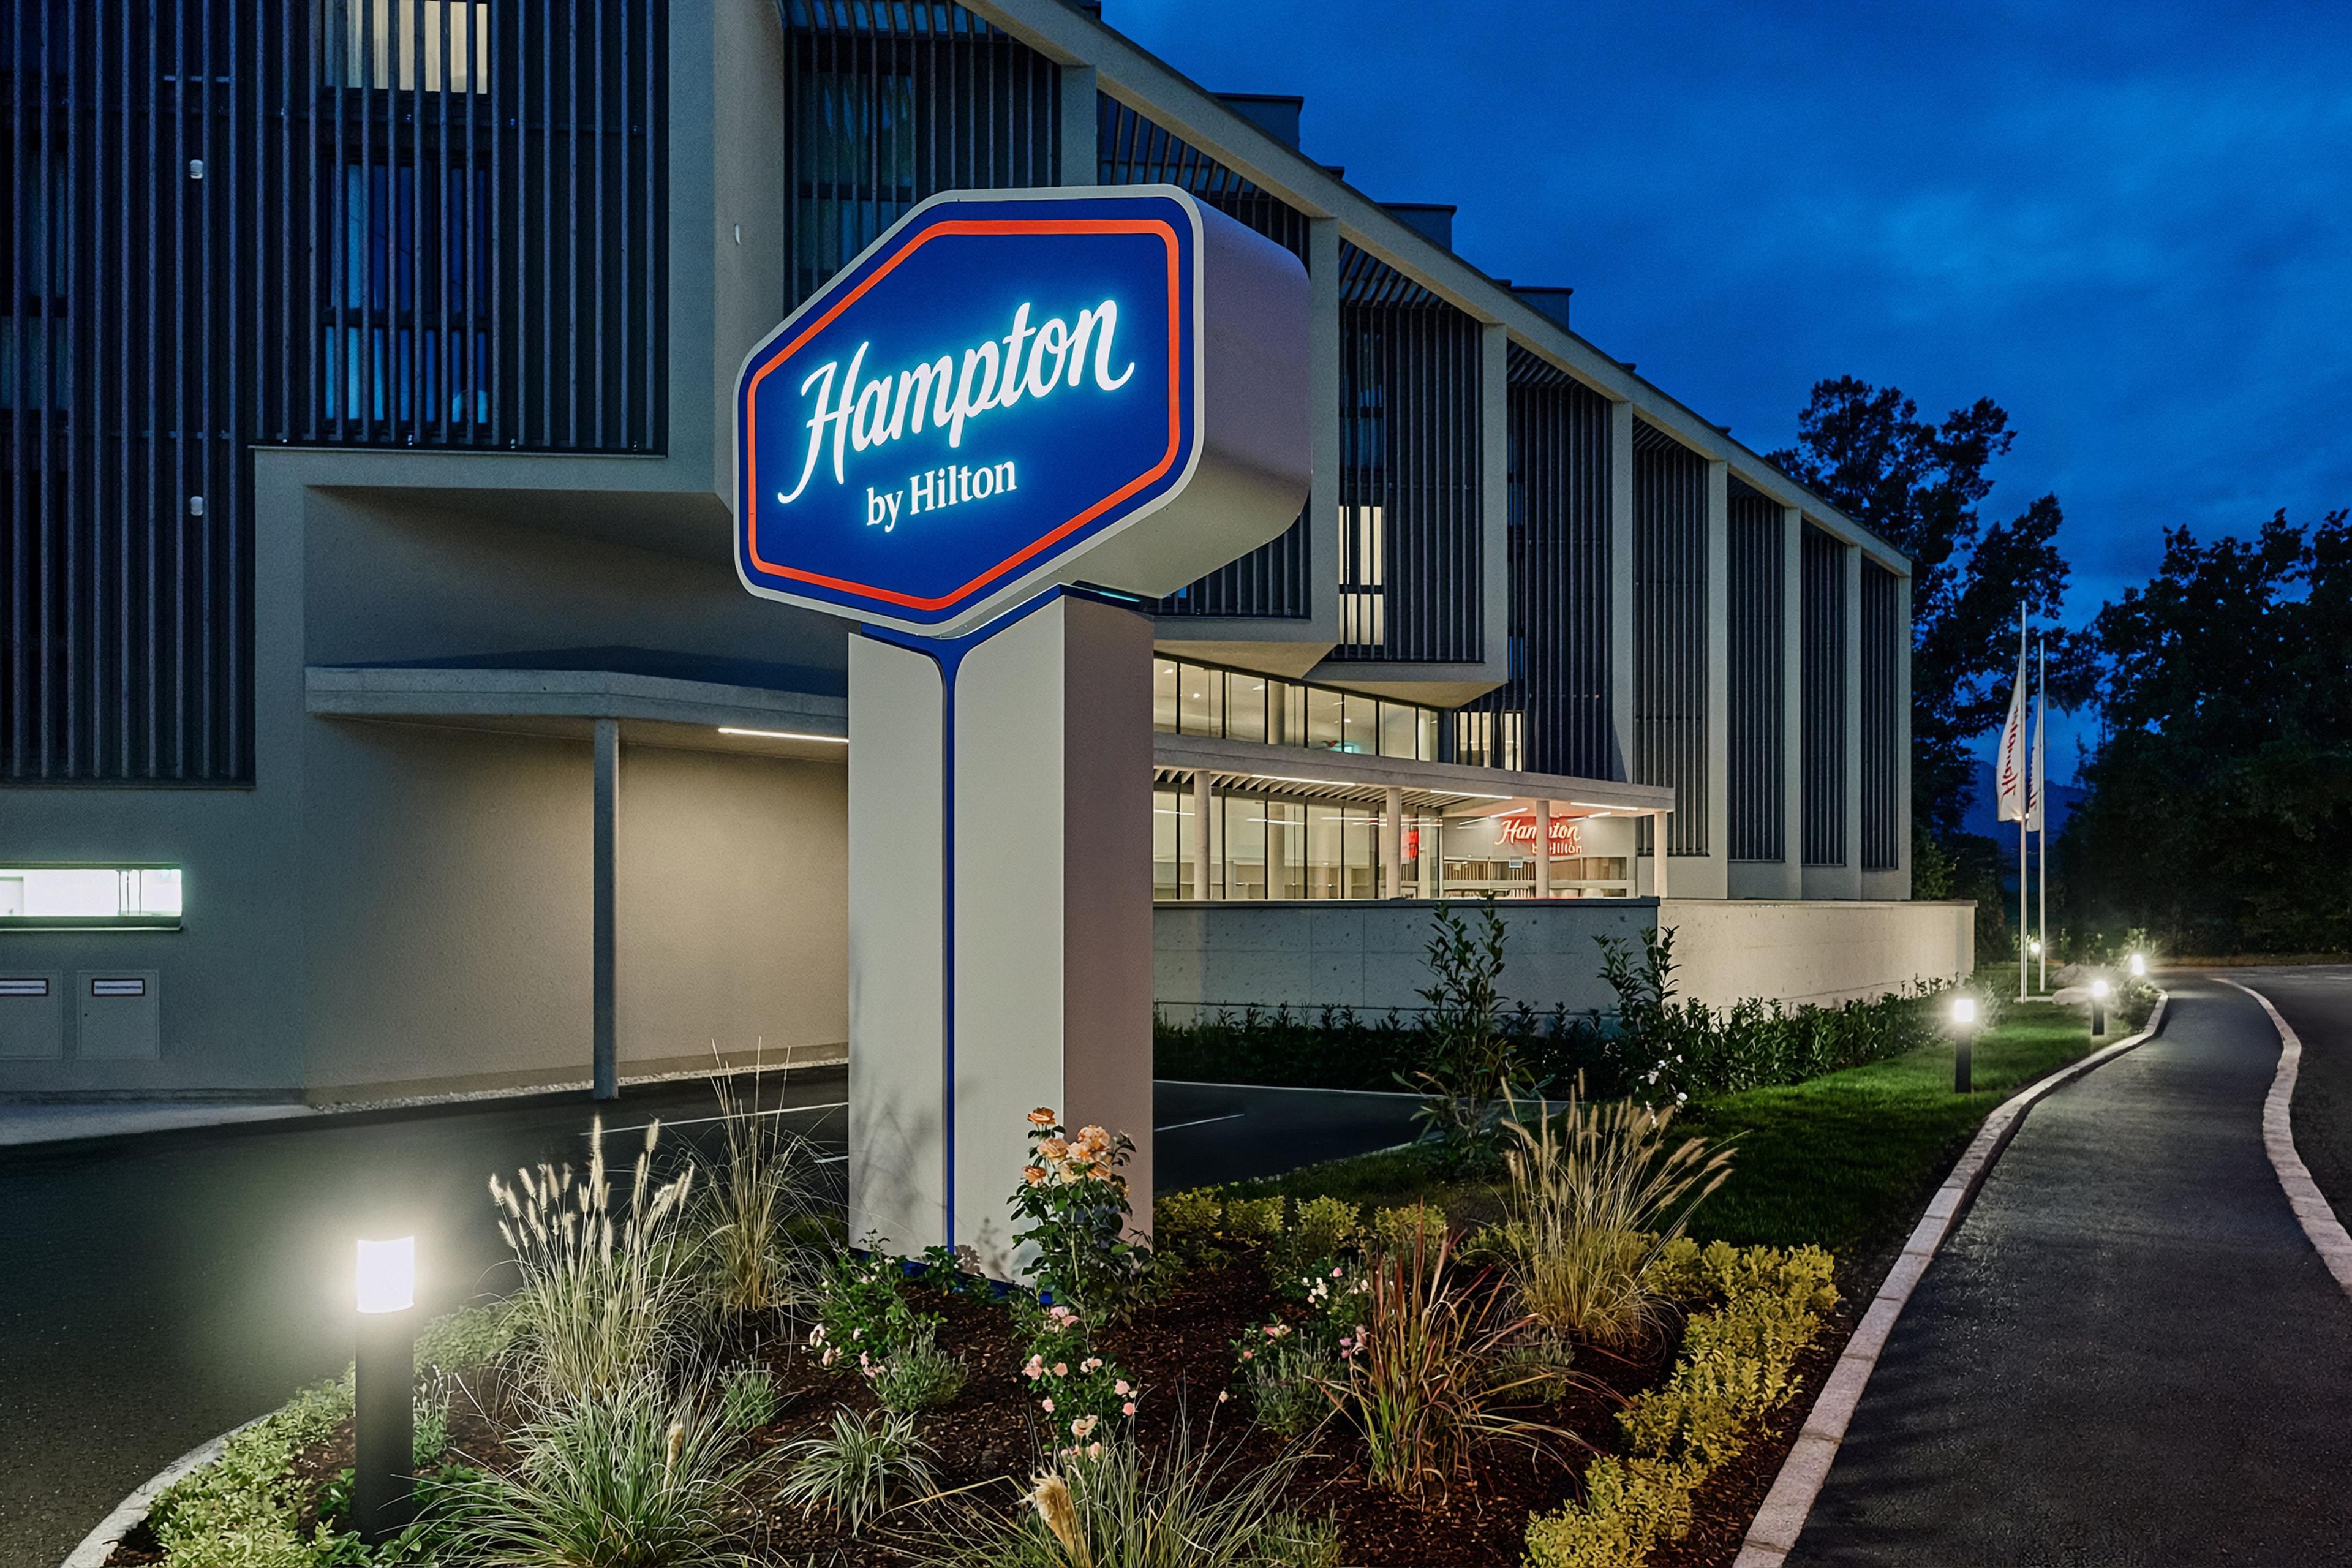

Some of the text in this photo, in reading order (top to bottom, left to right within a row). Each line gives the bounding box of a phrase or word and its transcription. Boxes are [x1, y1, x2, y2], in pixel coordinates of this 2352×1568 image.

[778, 299, 1135, 503] Hampton
[866, 461, 1017, 532] by Hilton
[1494, 819, 1581, 845] Hamton
